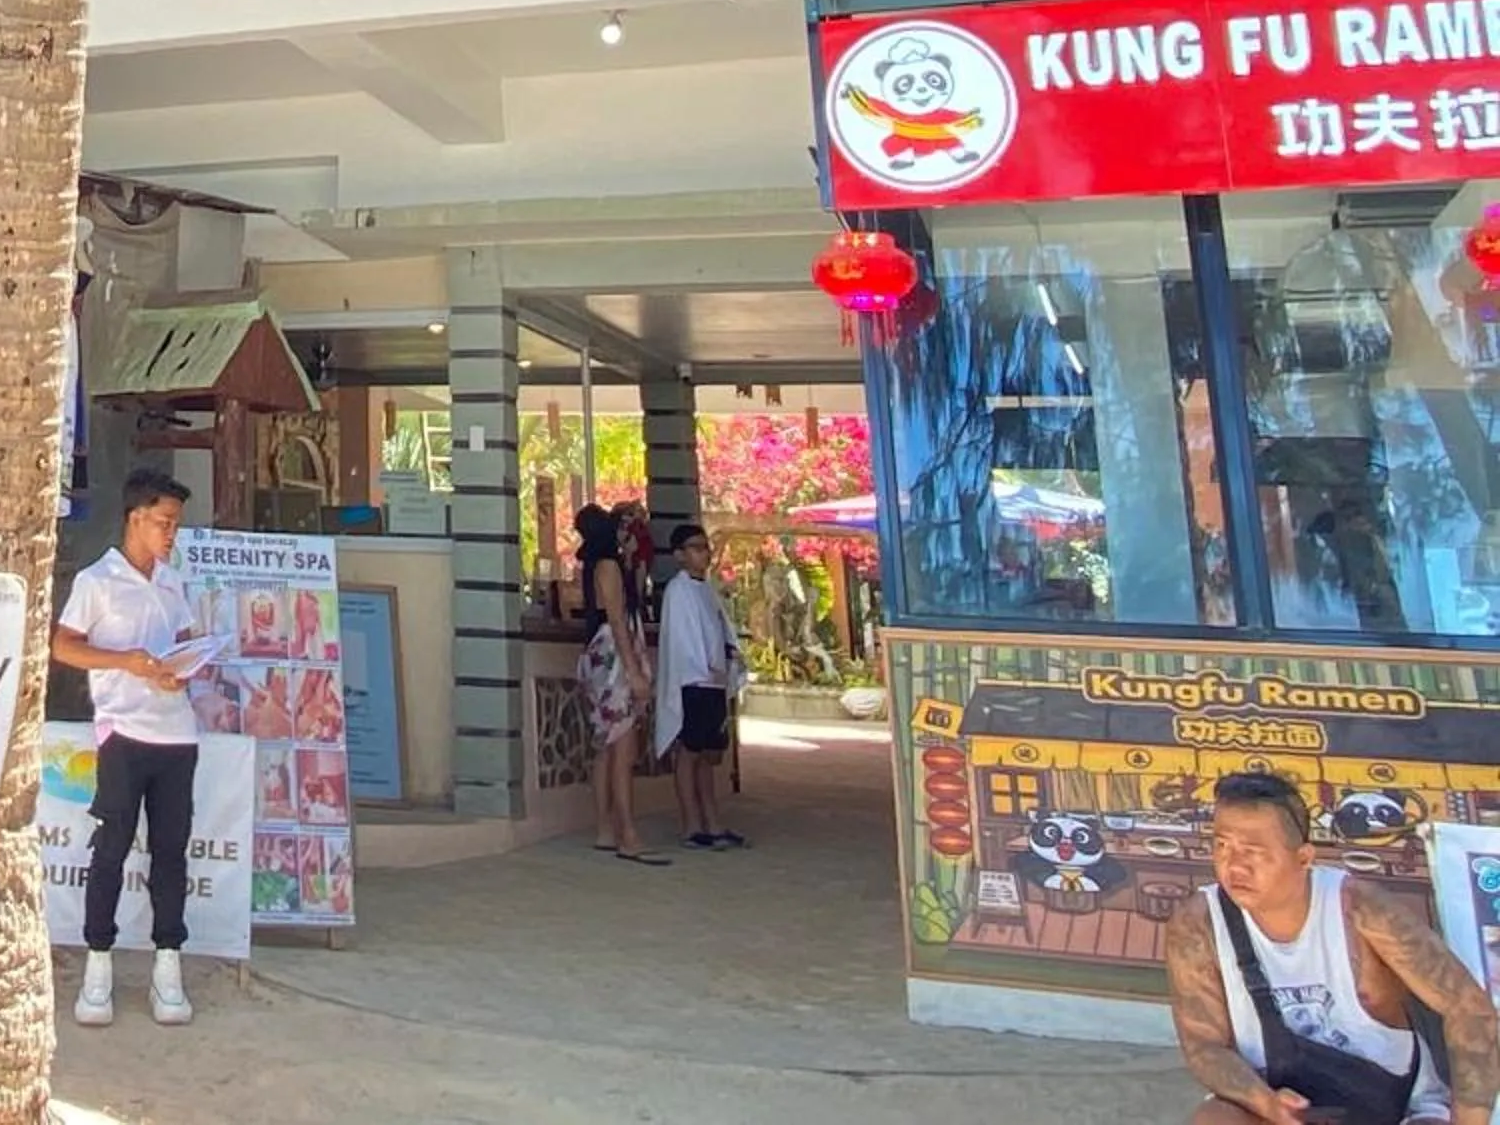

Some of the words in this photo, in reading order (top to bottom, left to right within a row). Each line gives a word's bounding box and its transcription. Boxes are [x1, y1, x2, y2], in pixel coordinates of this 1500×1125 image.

[1026, 20, 1204, 91] KUNG
[1225, 12, 1311, 76] FU
[187, 545, 287, 569] SERENITY
[293, 551, 331, 572] SPA
[1091, 673, 1244, 706] Kungfu
[1258, 679, 1415, 713] Ramen
[1180, 717, 1320, 749] 功夫拉面
